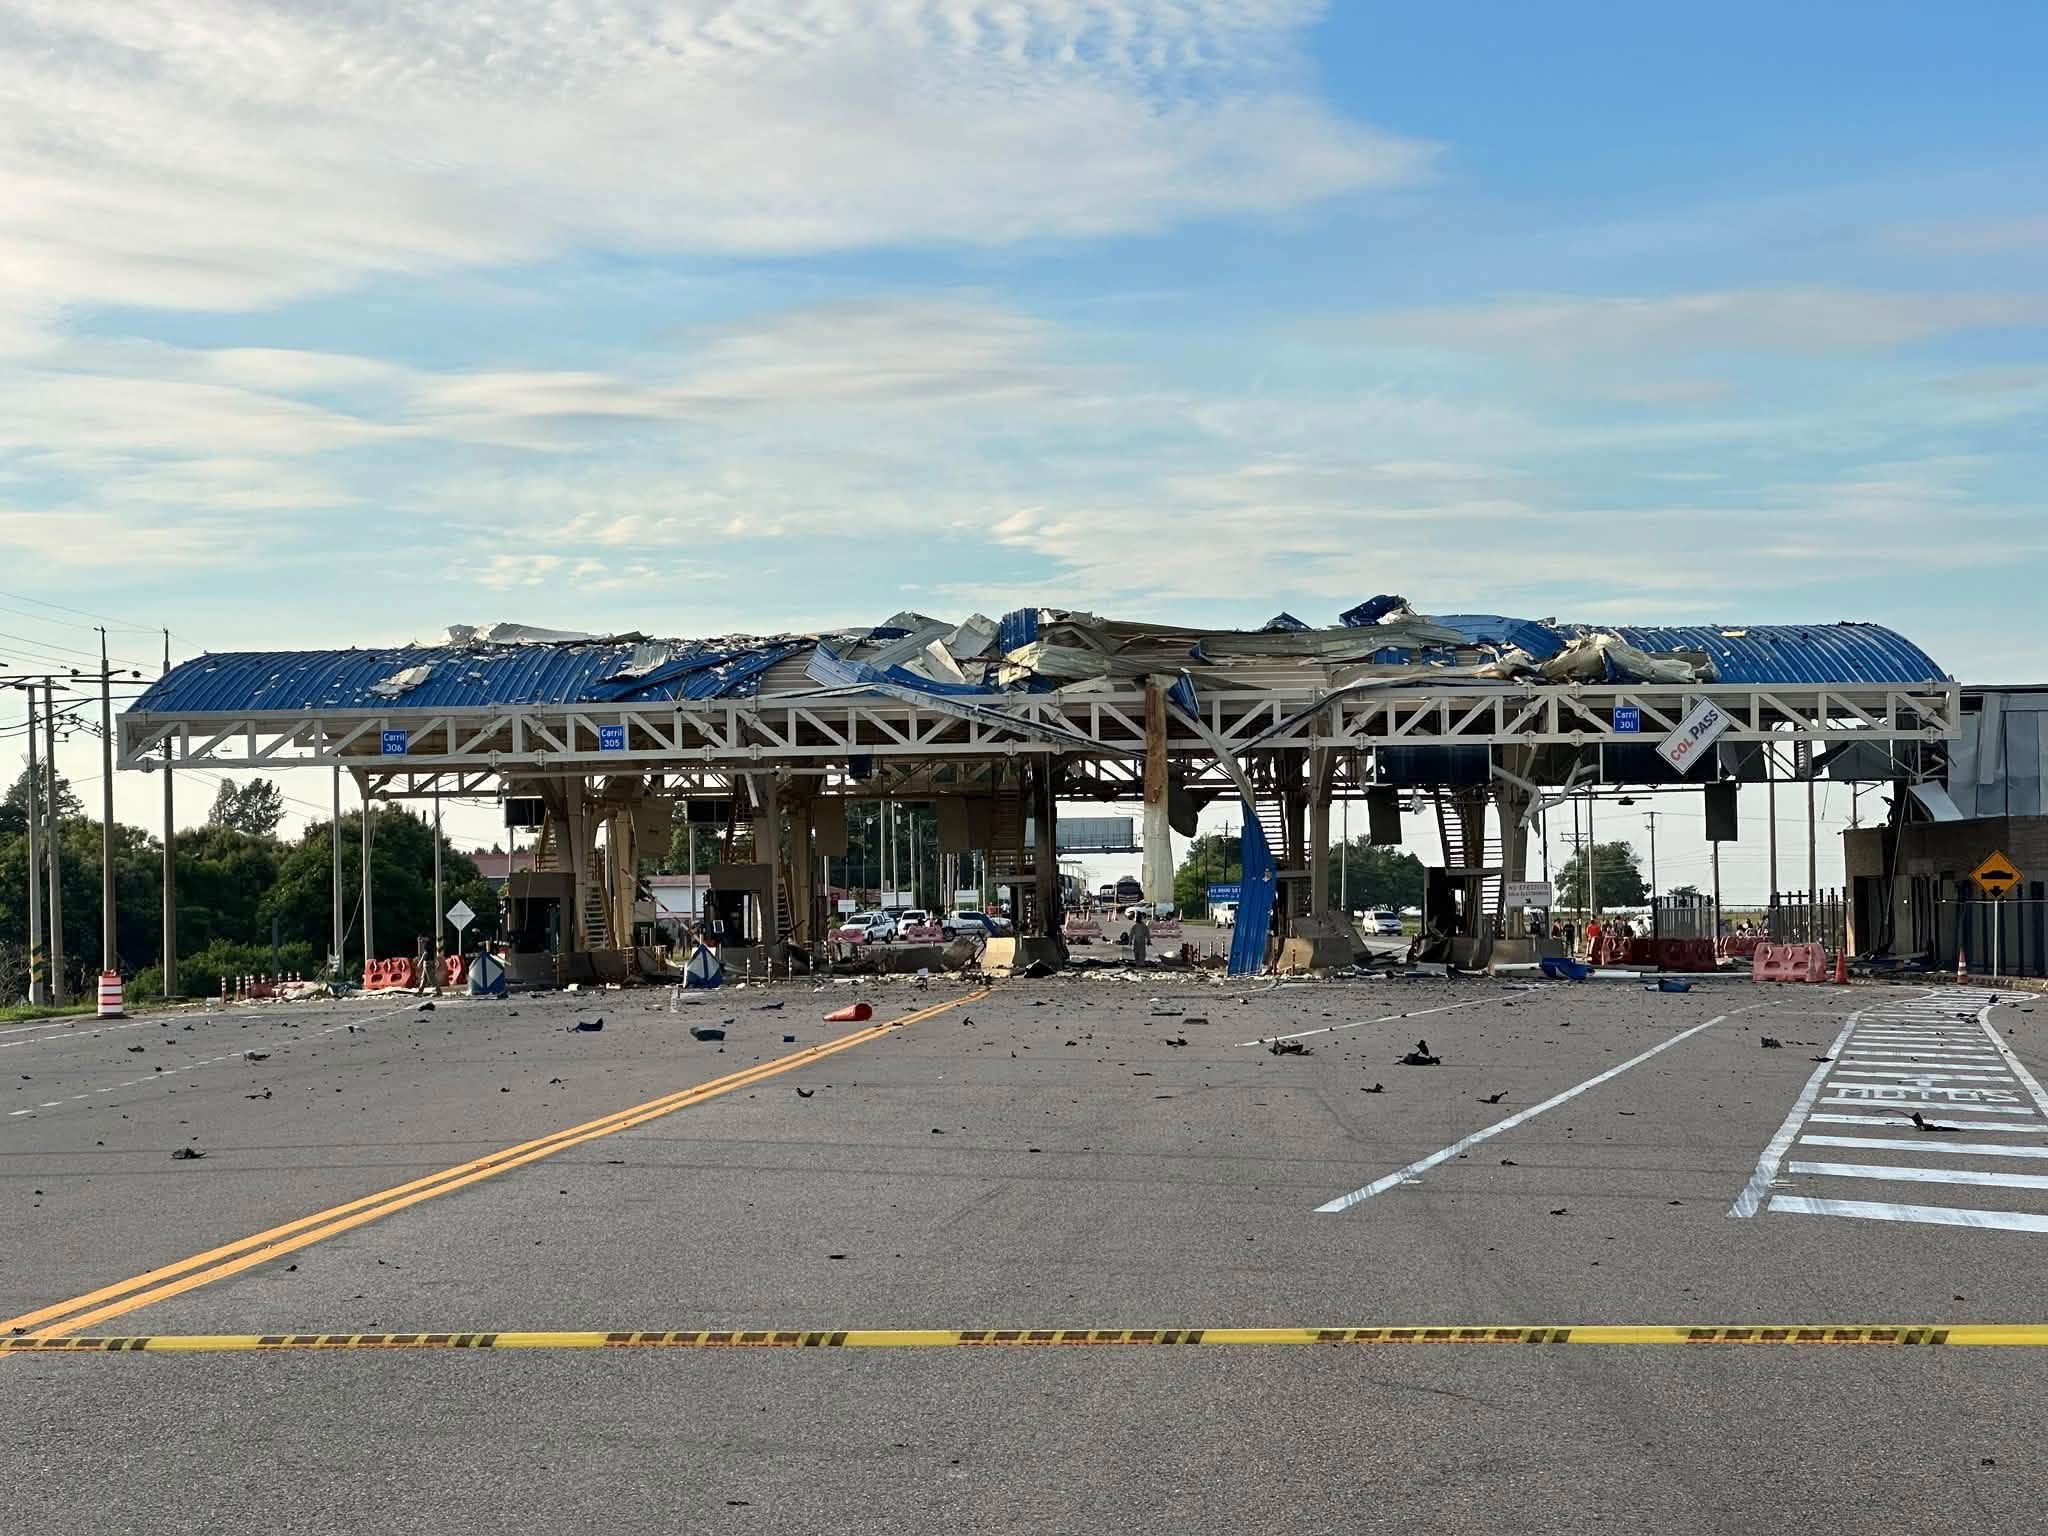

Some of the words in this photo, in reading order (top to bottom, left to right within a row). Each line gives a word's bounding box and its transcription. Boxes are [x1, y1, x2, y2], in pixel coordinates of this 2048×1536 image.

[1615, 710, 1638, 719] Carril
[1620, 720, 1634, 729] 301
[383, 732, 405, 741] Carril
[601, 728, 623, 737] Carril
[1670, 738, 1695, 761] COL
[1688, 709, 1719, 740] PASS
[386, 743, 403, 752] 306
[604, 739, 620, 747] 305
[1837, 1088, 2023, 1102] MOTOS
